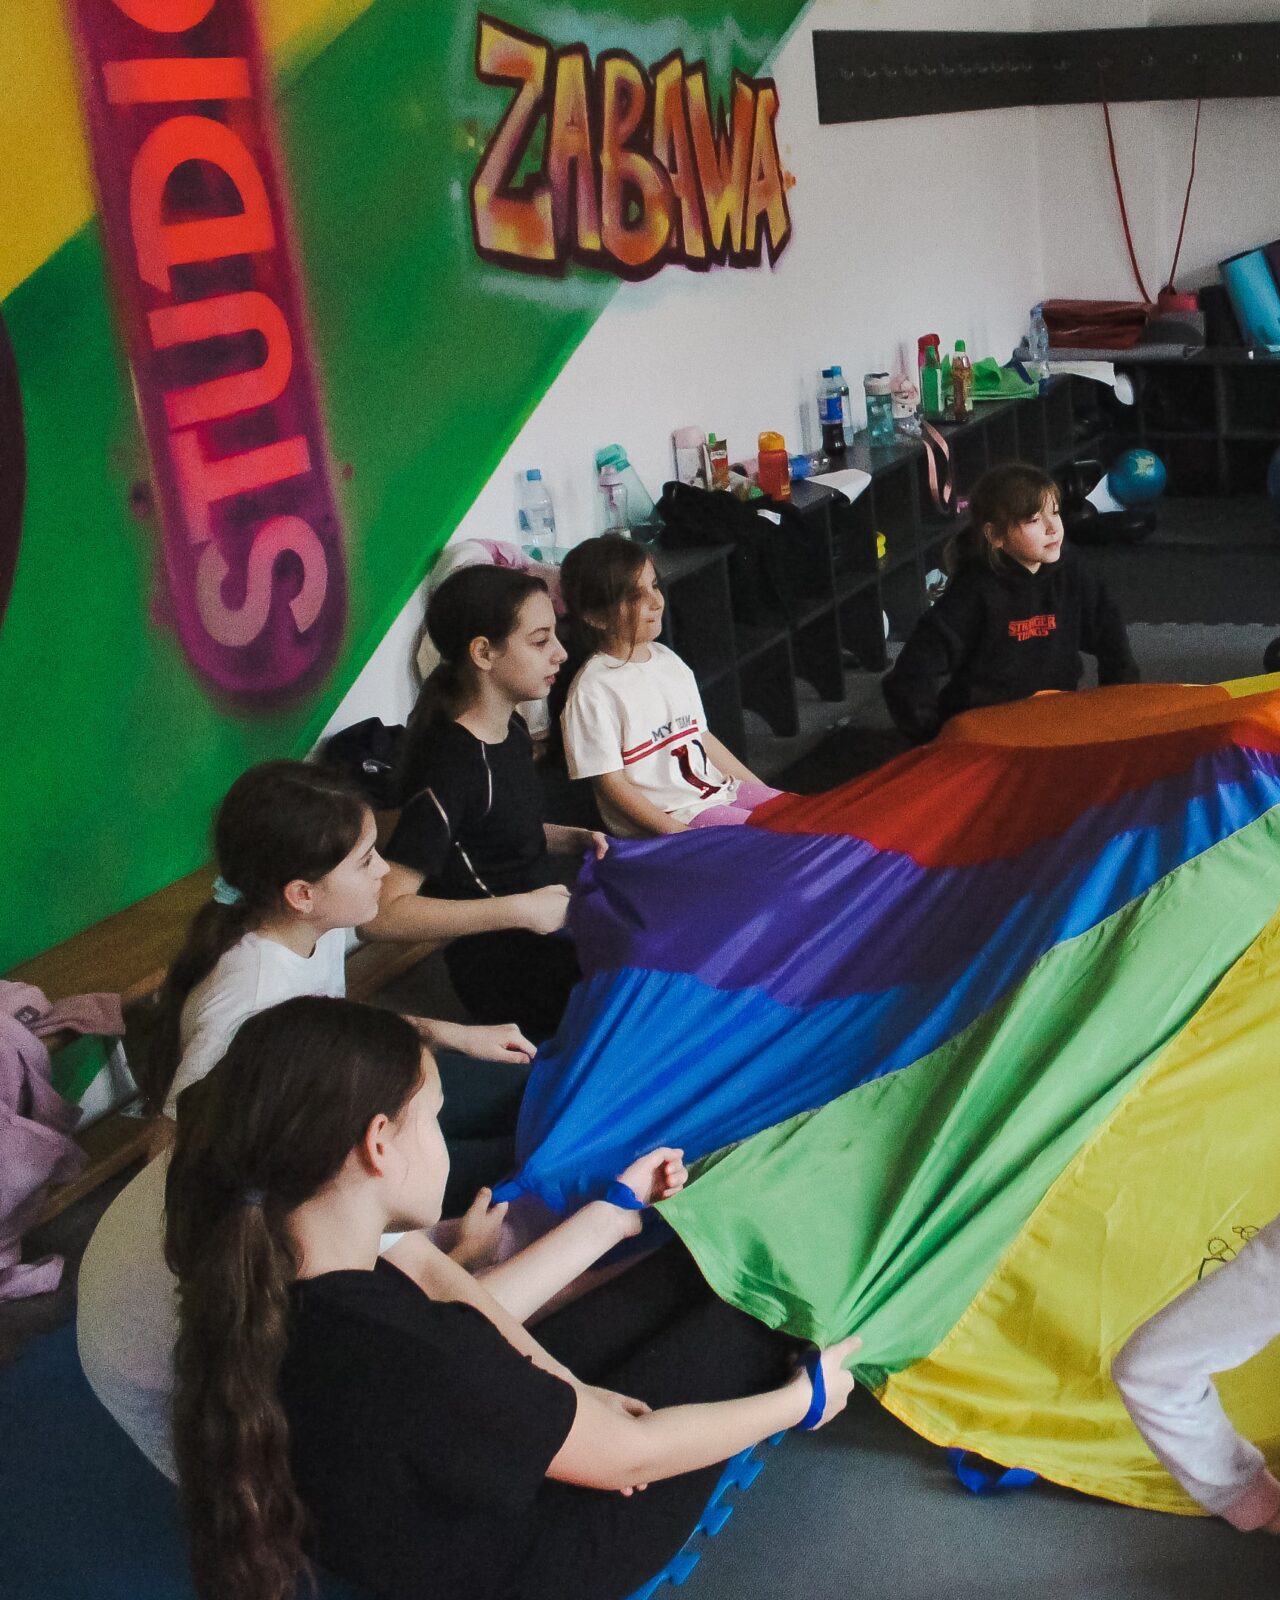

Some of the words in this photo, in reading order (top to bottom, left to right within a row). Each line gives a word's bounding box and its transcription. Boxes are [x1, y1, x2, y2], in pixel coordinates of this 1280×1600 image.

[470, 11, 792, 282] ZABAWA
[103, 0, 328, 648] STUDI
[651, 721, 672, 741] MY
